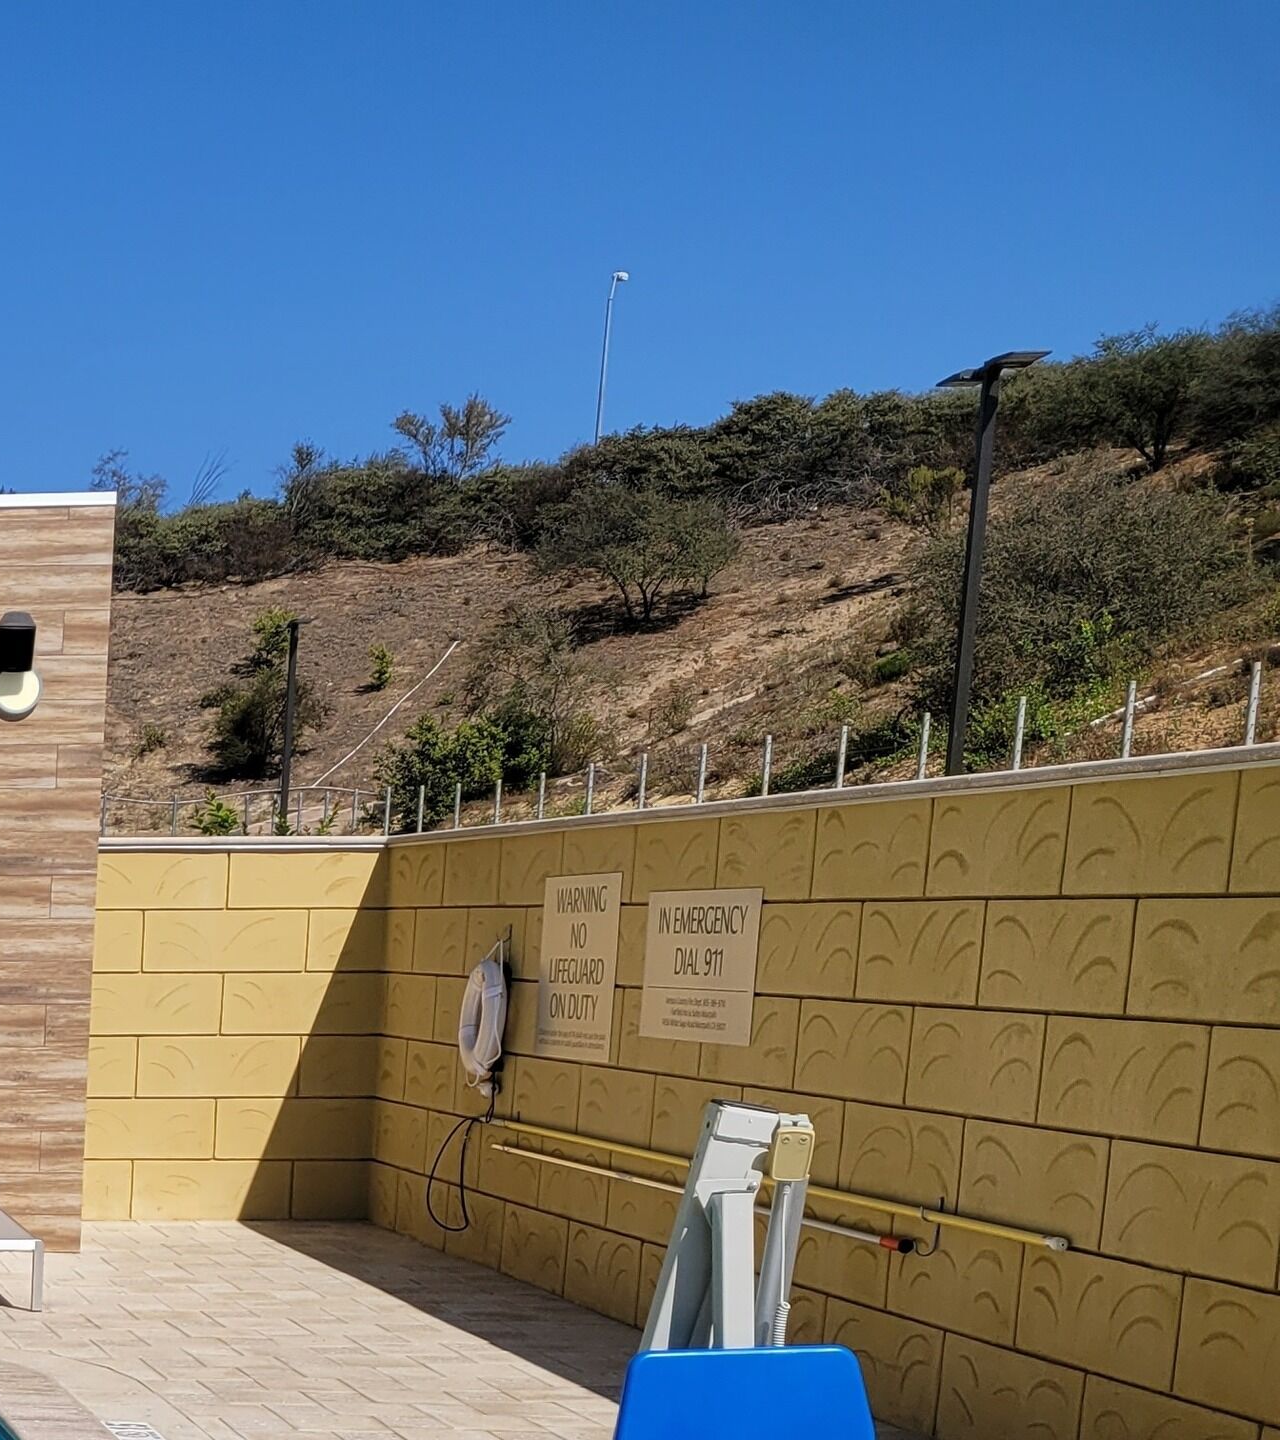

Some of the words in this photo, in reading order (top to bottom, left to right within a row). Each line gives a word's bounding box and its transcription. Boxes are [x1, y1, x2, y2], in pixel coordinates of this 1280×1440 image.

[557, 885, 608, 914] WARNING
[658, 907, 672, 934] IN
[673, 905, 749, 935] EMERGENCY
[570, 922, 587, 949] NO
[549, 958, 605, 985] LIFEGUARD
[674, 948, 700, 976] DIAL
[704, 948, 724, 976] 911
[549, 993, 568, 1019] ON
[568, 994, 598, 1020] DUTY
